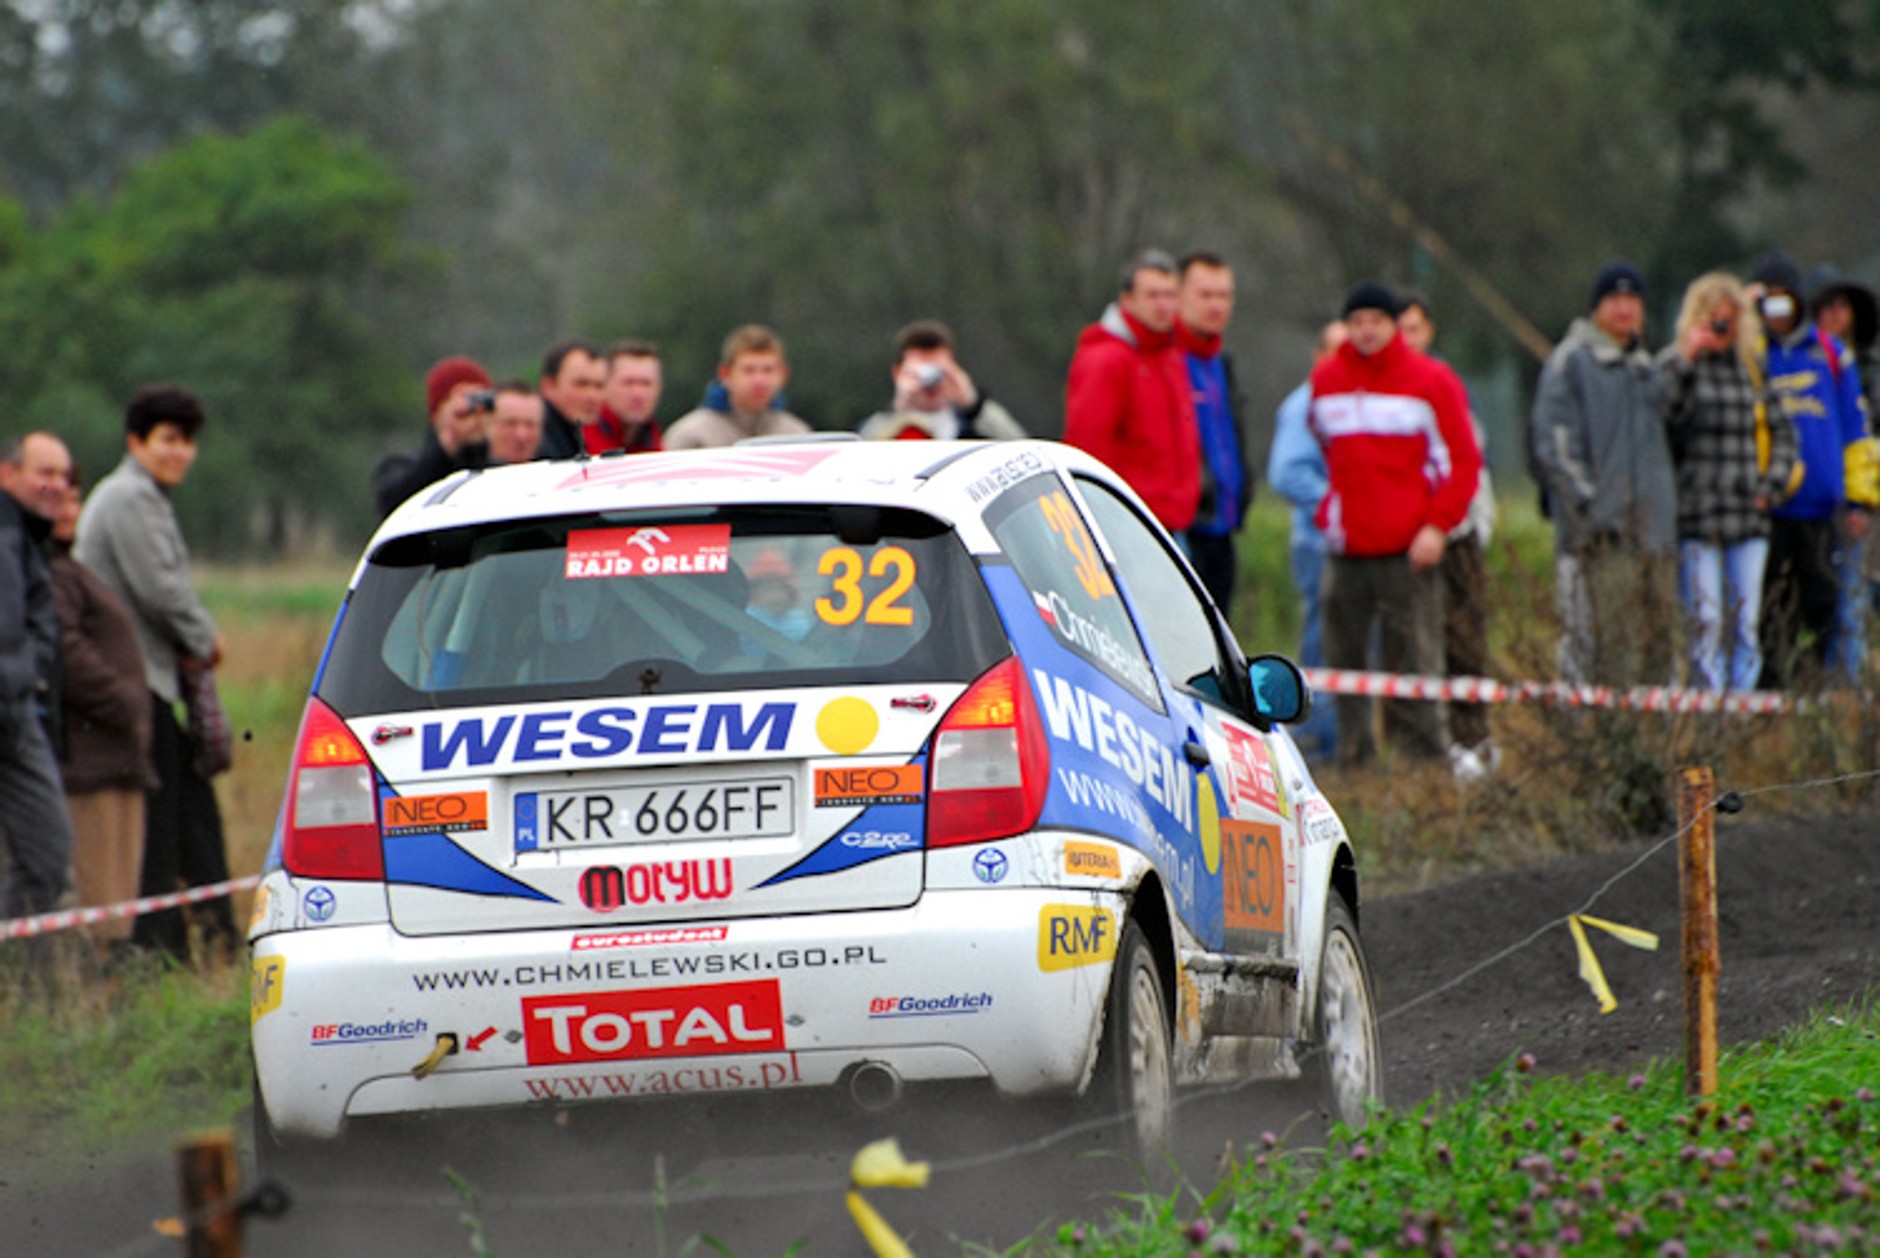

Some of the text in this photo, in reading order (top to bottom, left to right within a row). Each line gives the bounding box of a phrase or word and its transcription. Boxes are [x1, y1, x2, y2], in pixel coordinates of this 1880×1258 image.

[568, 558, 632, 577] RAJD
[641, 553, 728, 573] ORLEN
[815, 547, 916, 625] 32
[421, 703, 796, 770] WESEM
[1033, 668, 1193, 834] WESEM
[819, 769, 899, 793] NEO
[393, 796, 467, 821] NEO
[548, 786, 782, 842] KR 666FF
[518, 828, 535, 841] PL
[1224, 830, 1275, 918] NEO
[1051, 917, 1107, 955] RMF
[413, 947, 886, 991] WWW.CHMIELEWSKI.GO.PL
[869, 992, 992, 1018] BFGoodrich
[311, 1018, 427, 1045] BFGoodrich
[523, 1051, 802, 1100] www.acus.pl
